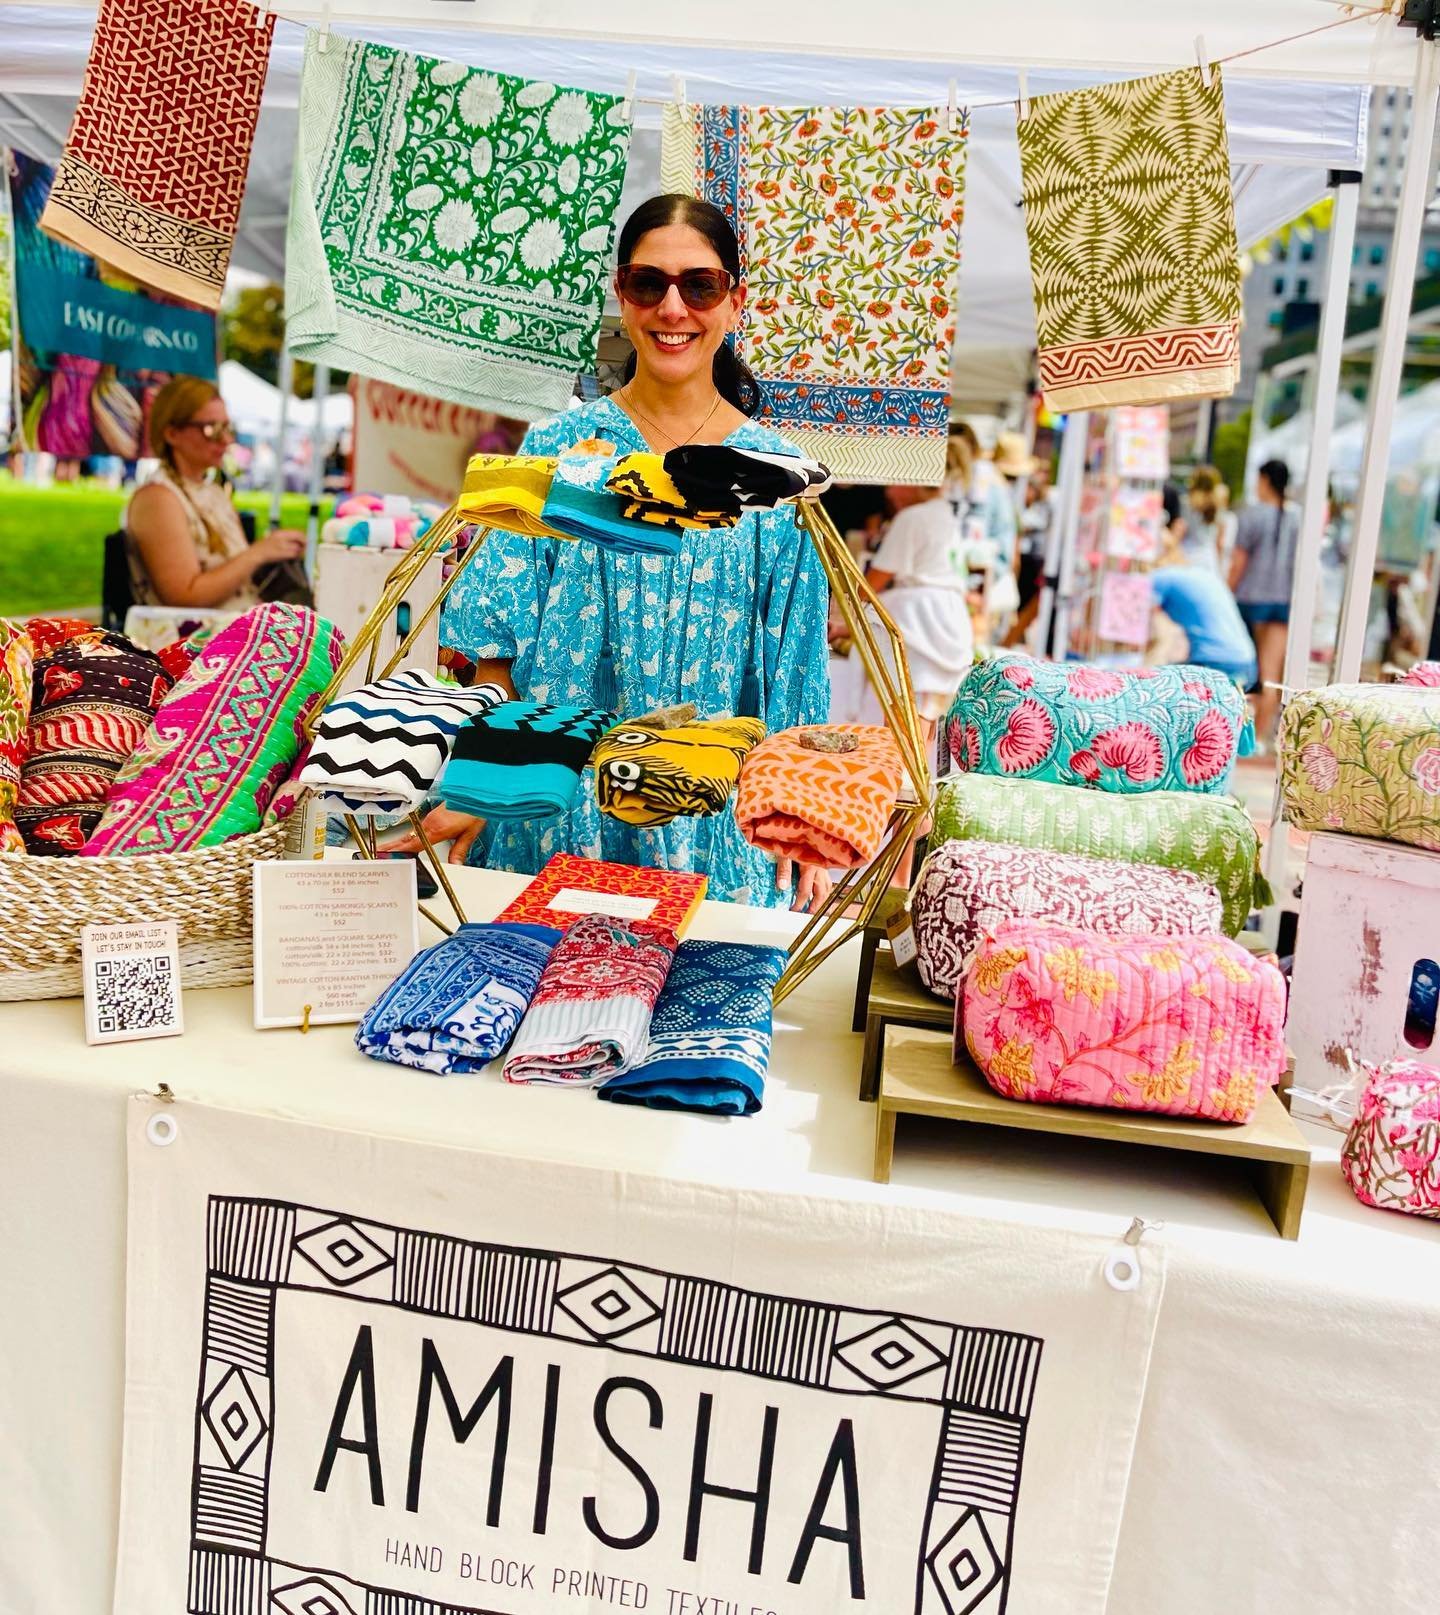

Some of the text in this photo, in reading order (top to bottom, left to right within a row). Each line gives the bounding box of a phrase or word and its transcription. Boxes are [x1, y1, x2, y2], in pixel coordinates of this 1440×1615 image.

[91, 932, 108, 942] JOIN
[110, 931, 122, 940] OUR
[126, 930, 144, 938] EMAIL
[148, 928, 162, 937] LIST
[96, 944, 114, 952] LET'S
[117, 942, 132, 952] STAY
[135, 942, 142, 950] IN
[314, 1325, 866, 1600] AMISHA
[386, 1538, 443, 1573] HAND
[460, 1552, 534, 1590] BLOCK
[552, 1568, 648, 1610] PRINTED
